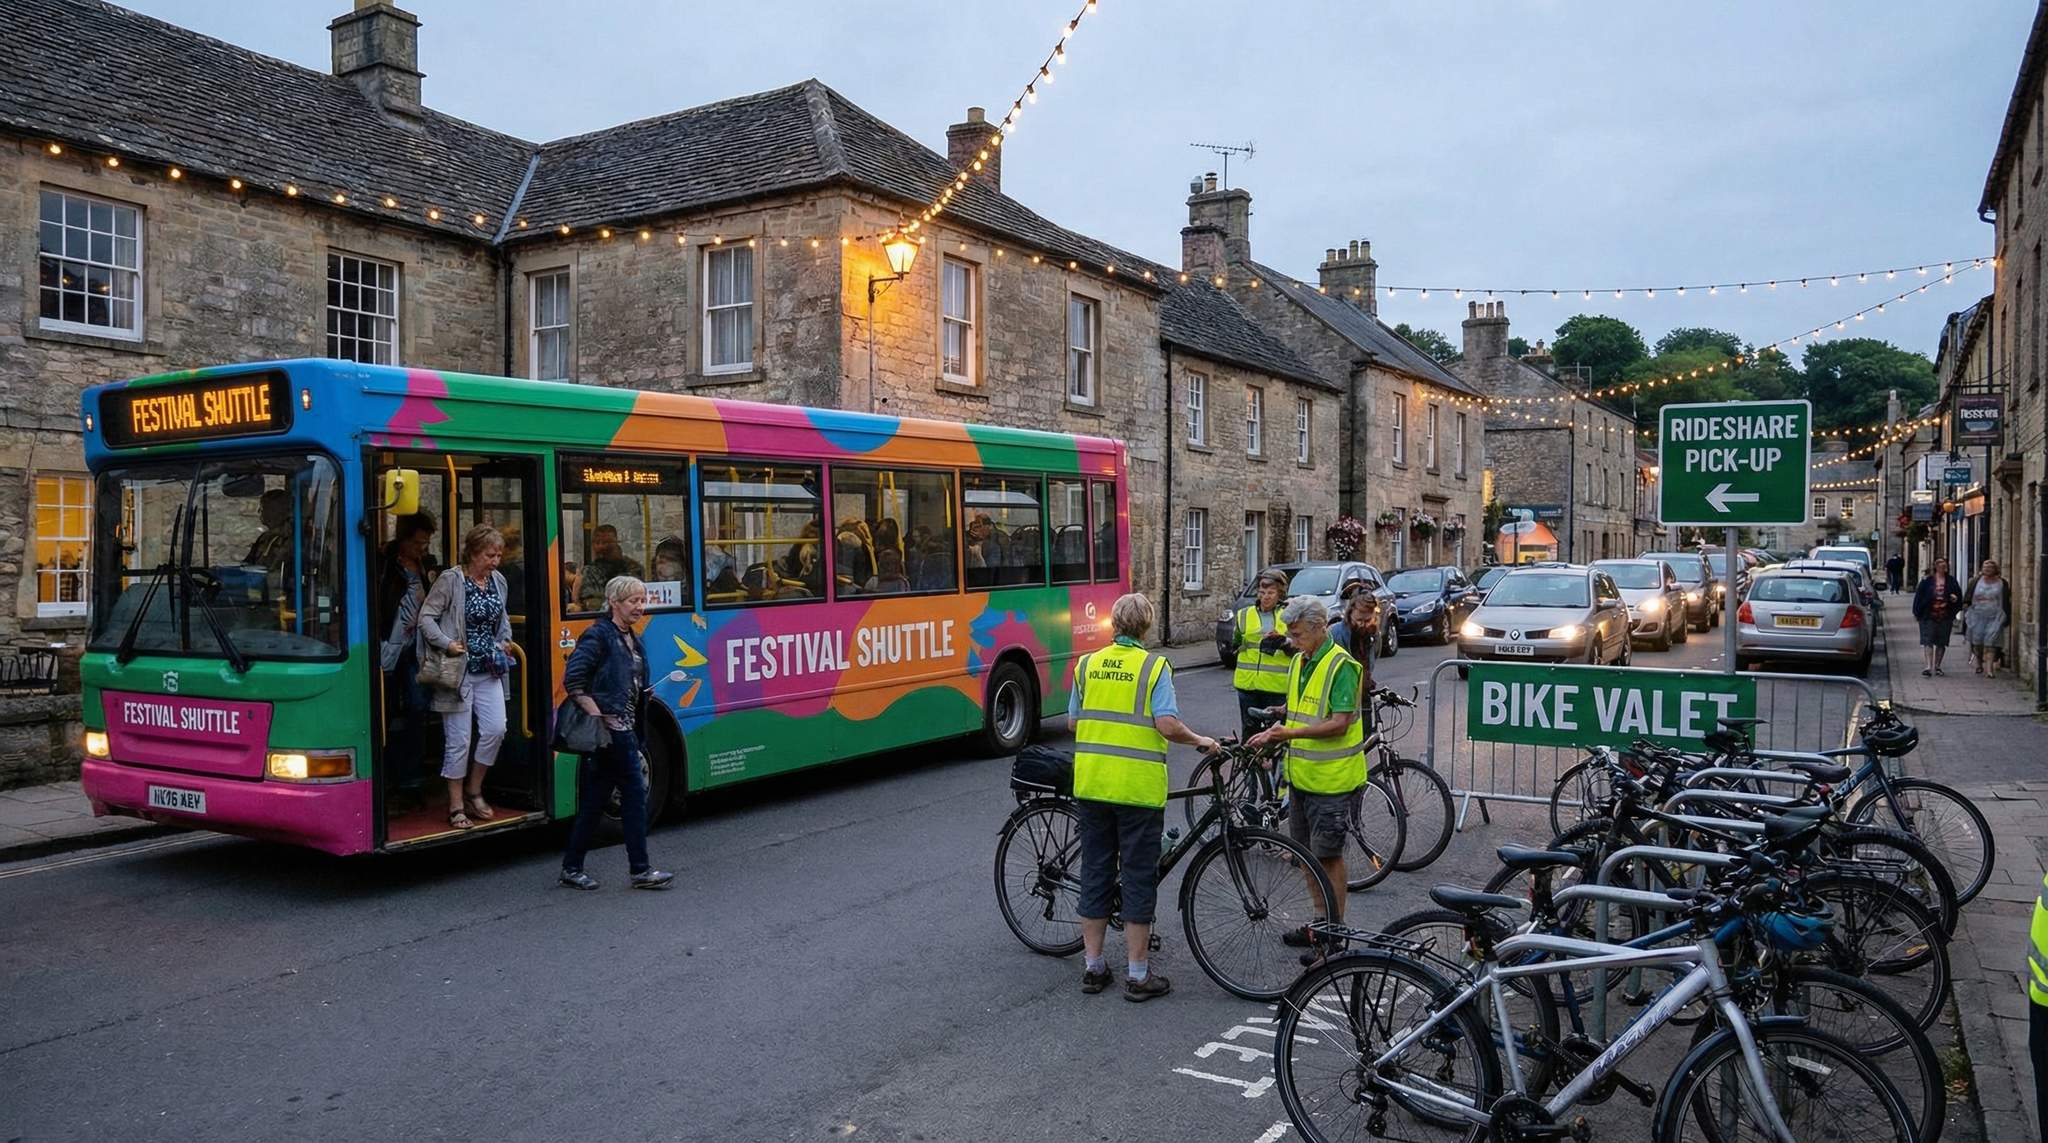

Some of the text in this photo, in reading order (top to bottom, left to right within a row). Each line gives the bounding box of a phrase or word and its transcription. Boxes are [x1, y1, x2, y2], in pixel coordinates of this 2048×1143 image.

[132, 384, 271, 433] FESTIVAL SHUTTLE
[1671, 414, 1799, 441] RIDESHARE
[1685, 448, 1782, 472] PICK-UP
[726, 619, 954, 683] FESTIVAL SHUTTLE
[124, 702, 240, 734] FESTIVAL SHUTTLE
[1482, 681, 1738, 738] BIKE VALET
